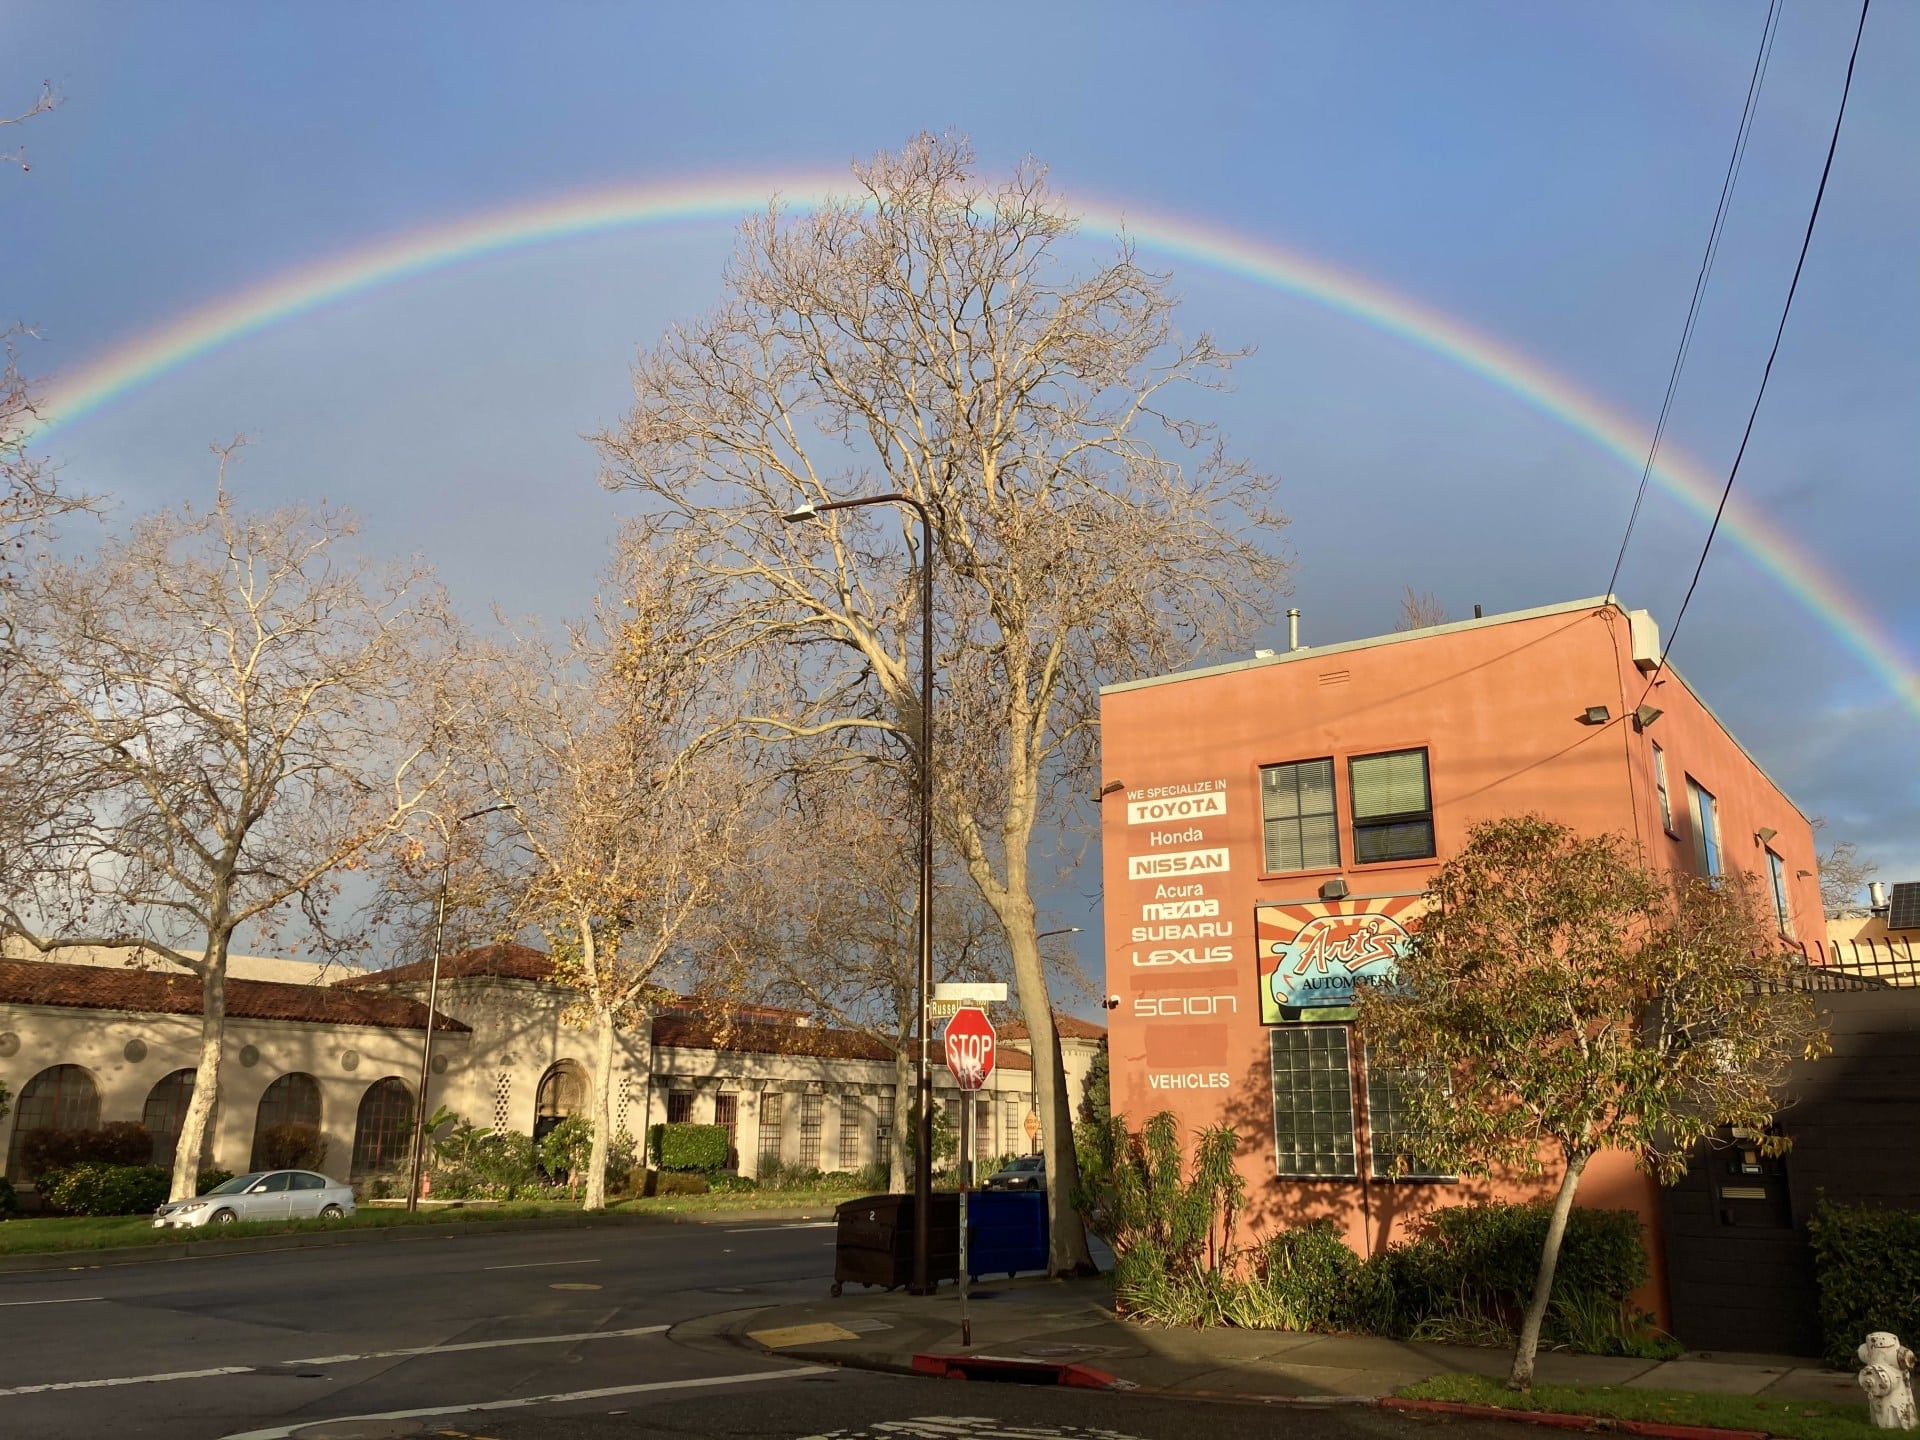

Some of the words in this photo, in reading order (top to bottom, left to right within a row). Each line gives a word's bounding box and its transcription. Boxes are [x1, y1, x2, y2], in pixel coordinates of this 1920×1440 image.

[1127, 789, 1145, 801] WE
[1147, 781, 1212, 798] SPECIALIZE
[1214, 779, 1227, 790] IN
[1136, 797, 1218, 820] TOYOTA
[1150, 827, 1203, 846] Honda
[1135, 852, 1223, 875] NISSAN
[1155, 881, 1204, 899] Acura
[1131, 920, 1233, 942] SUBARU
[1132, 946, 1233, 966] LEXUS
[1293, 920, 1397, 975] Art's
[1134, 995, 1237, 1017] SCION
[949, 1033, 992, 1065] STOP
[1149, 1073, 1230, 1090] VEHICLES
[869, 1210, 876, 1221] 2
